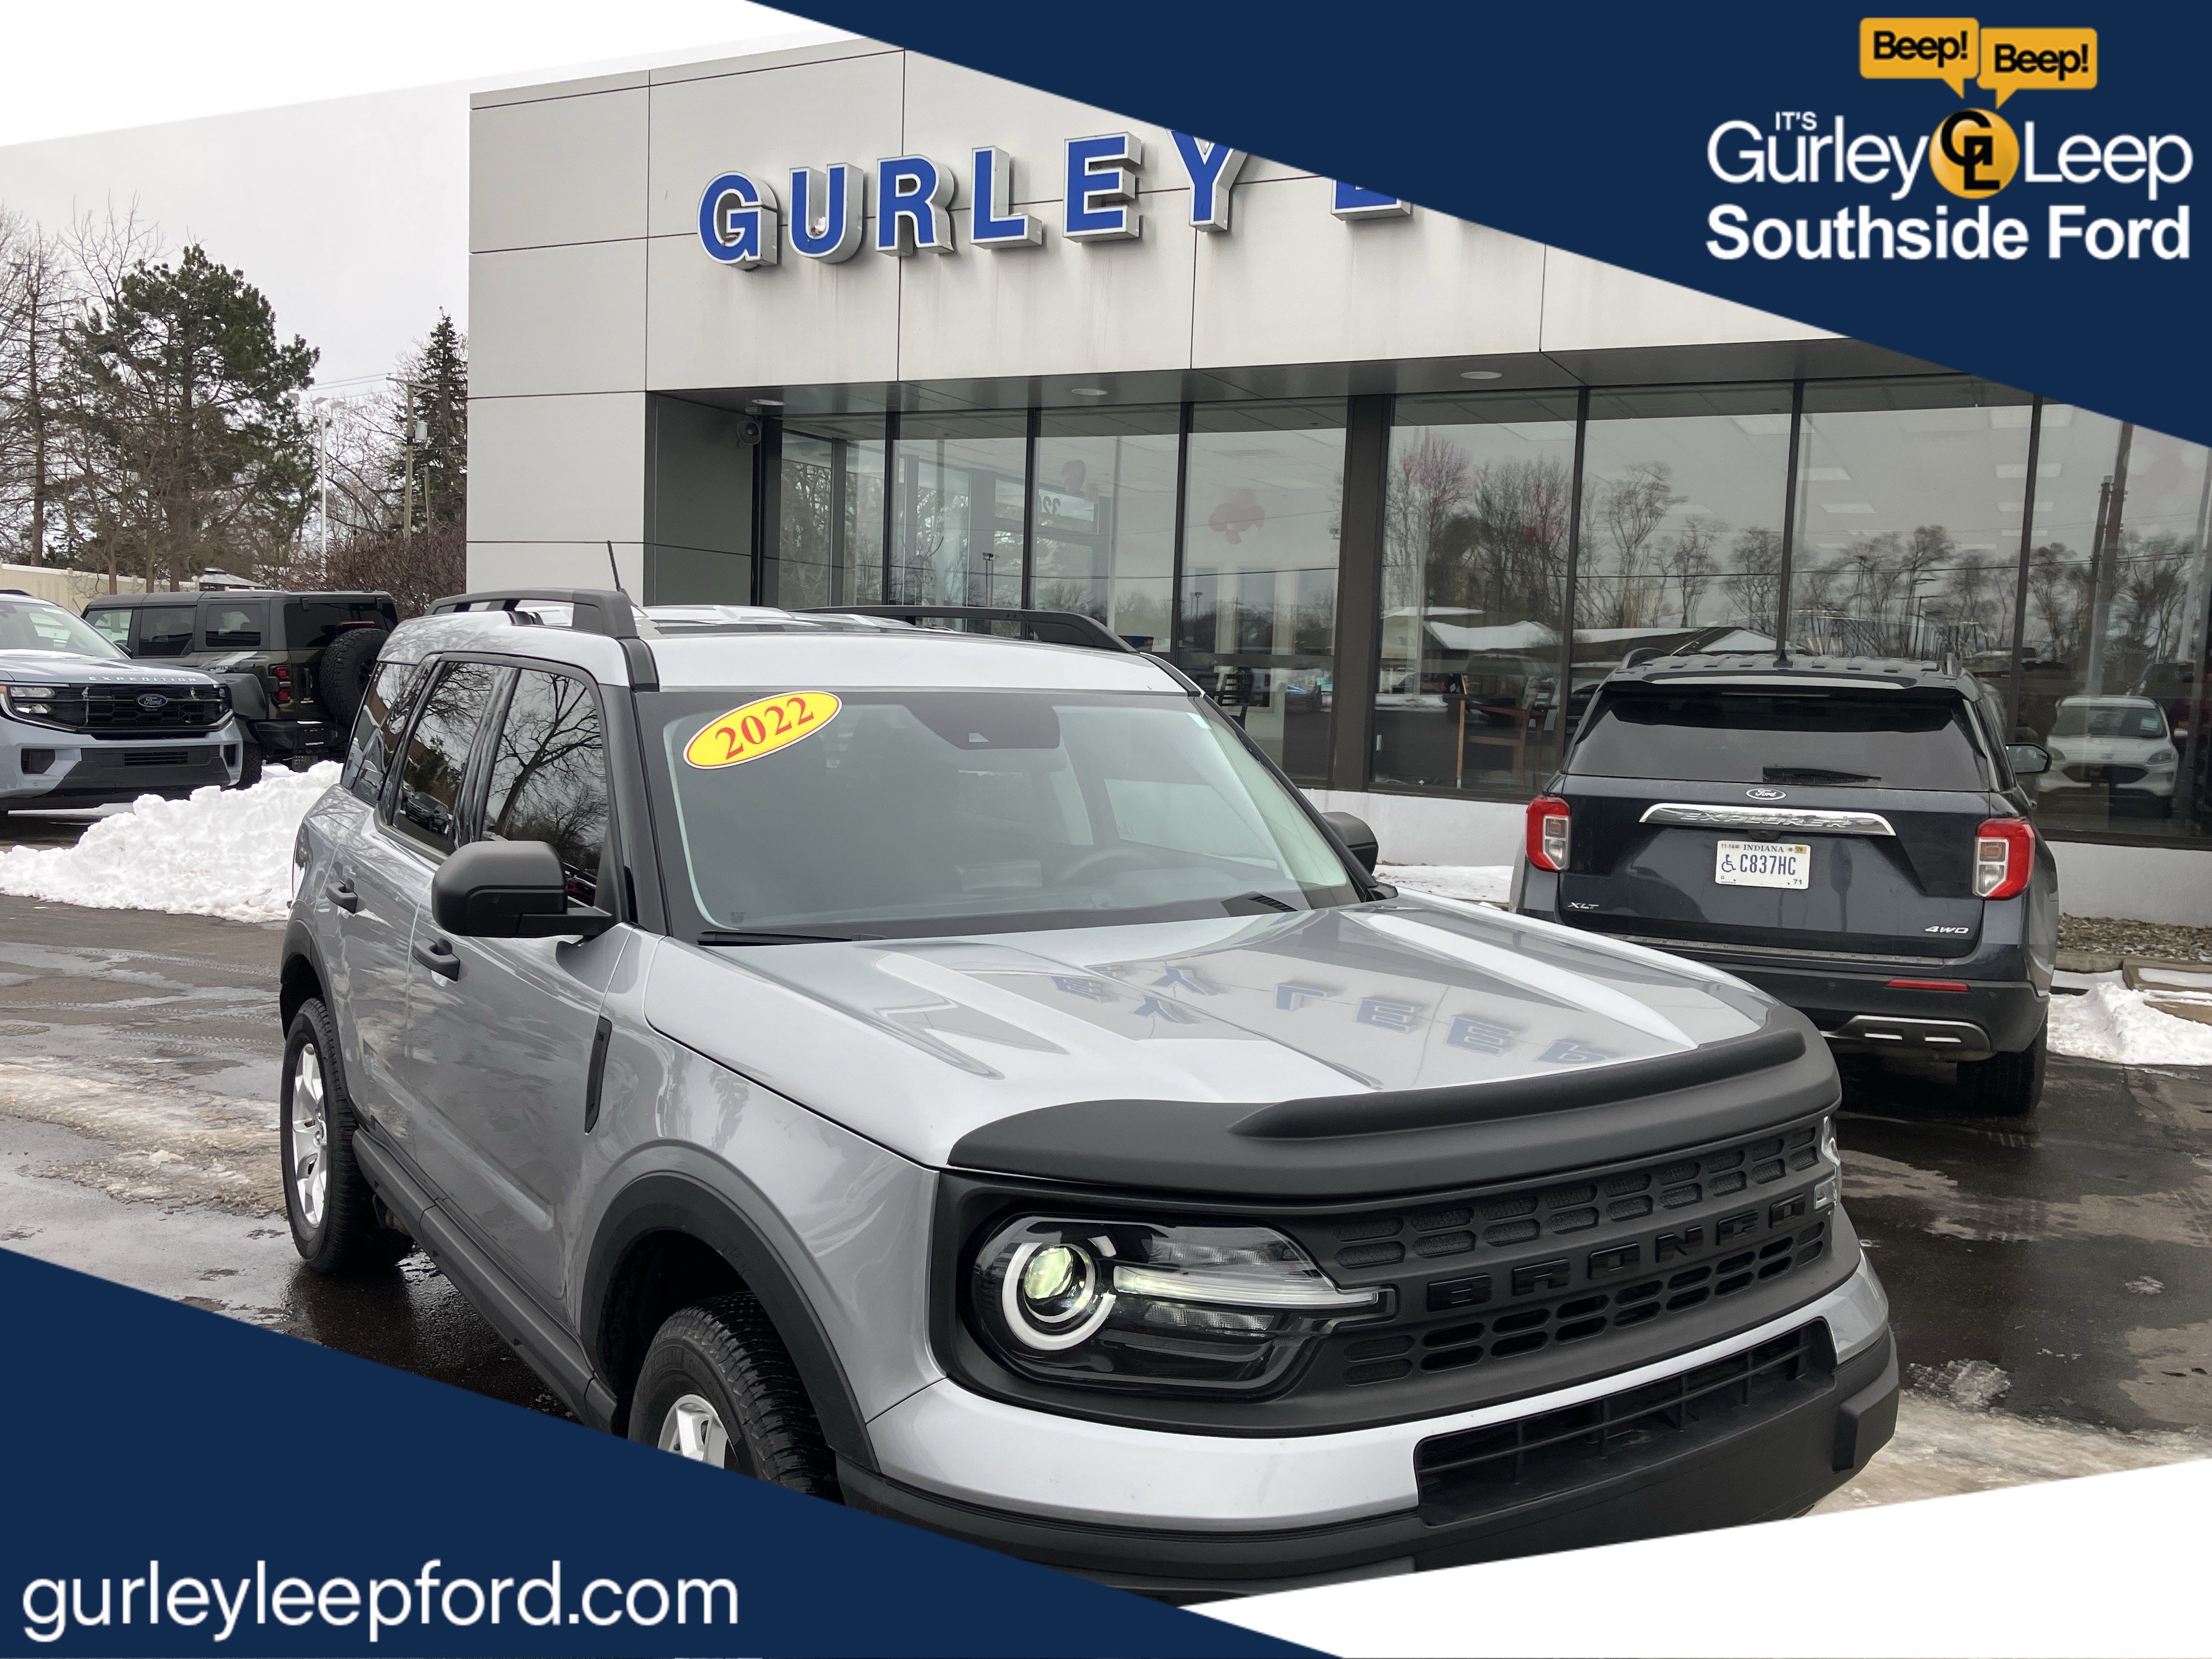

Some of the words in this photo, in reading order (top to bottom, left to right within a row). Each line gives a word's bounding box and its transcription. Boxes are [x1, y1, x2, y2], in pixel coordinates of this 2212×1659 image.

[697, 129, 1248, 270] GURLEY
[715, 697, 815, 760] 2022
[1680, 812, 1853, 828] EXPLORER
[1743, 844, 1784, 853] INDIANA
[1740, 854, 1797, 876] C837HC
[1925, 926, 1970, 934] 4WD
[1427, 1194, 1806, 1312] BRONCO
